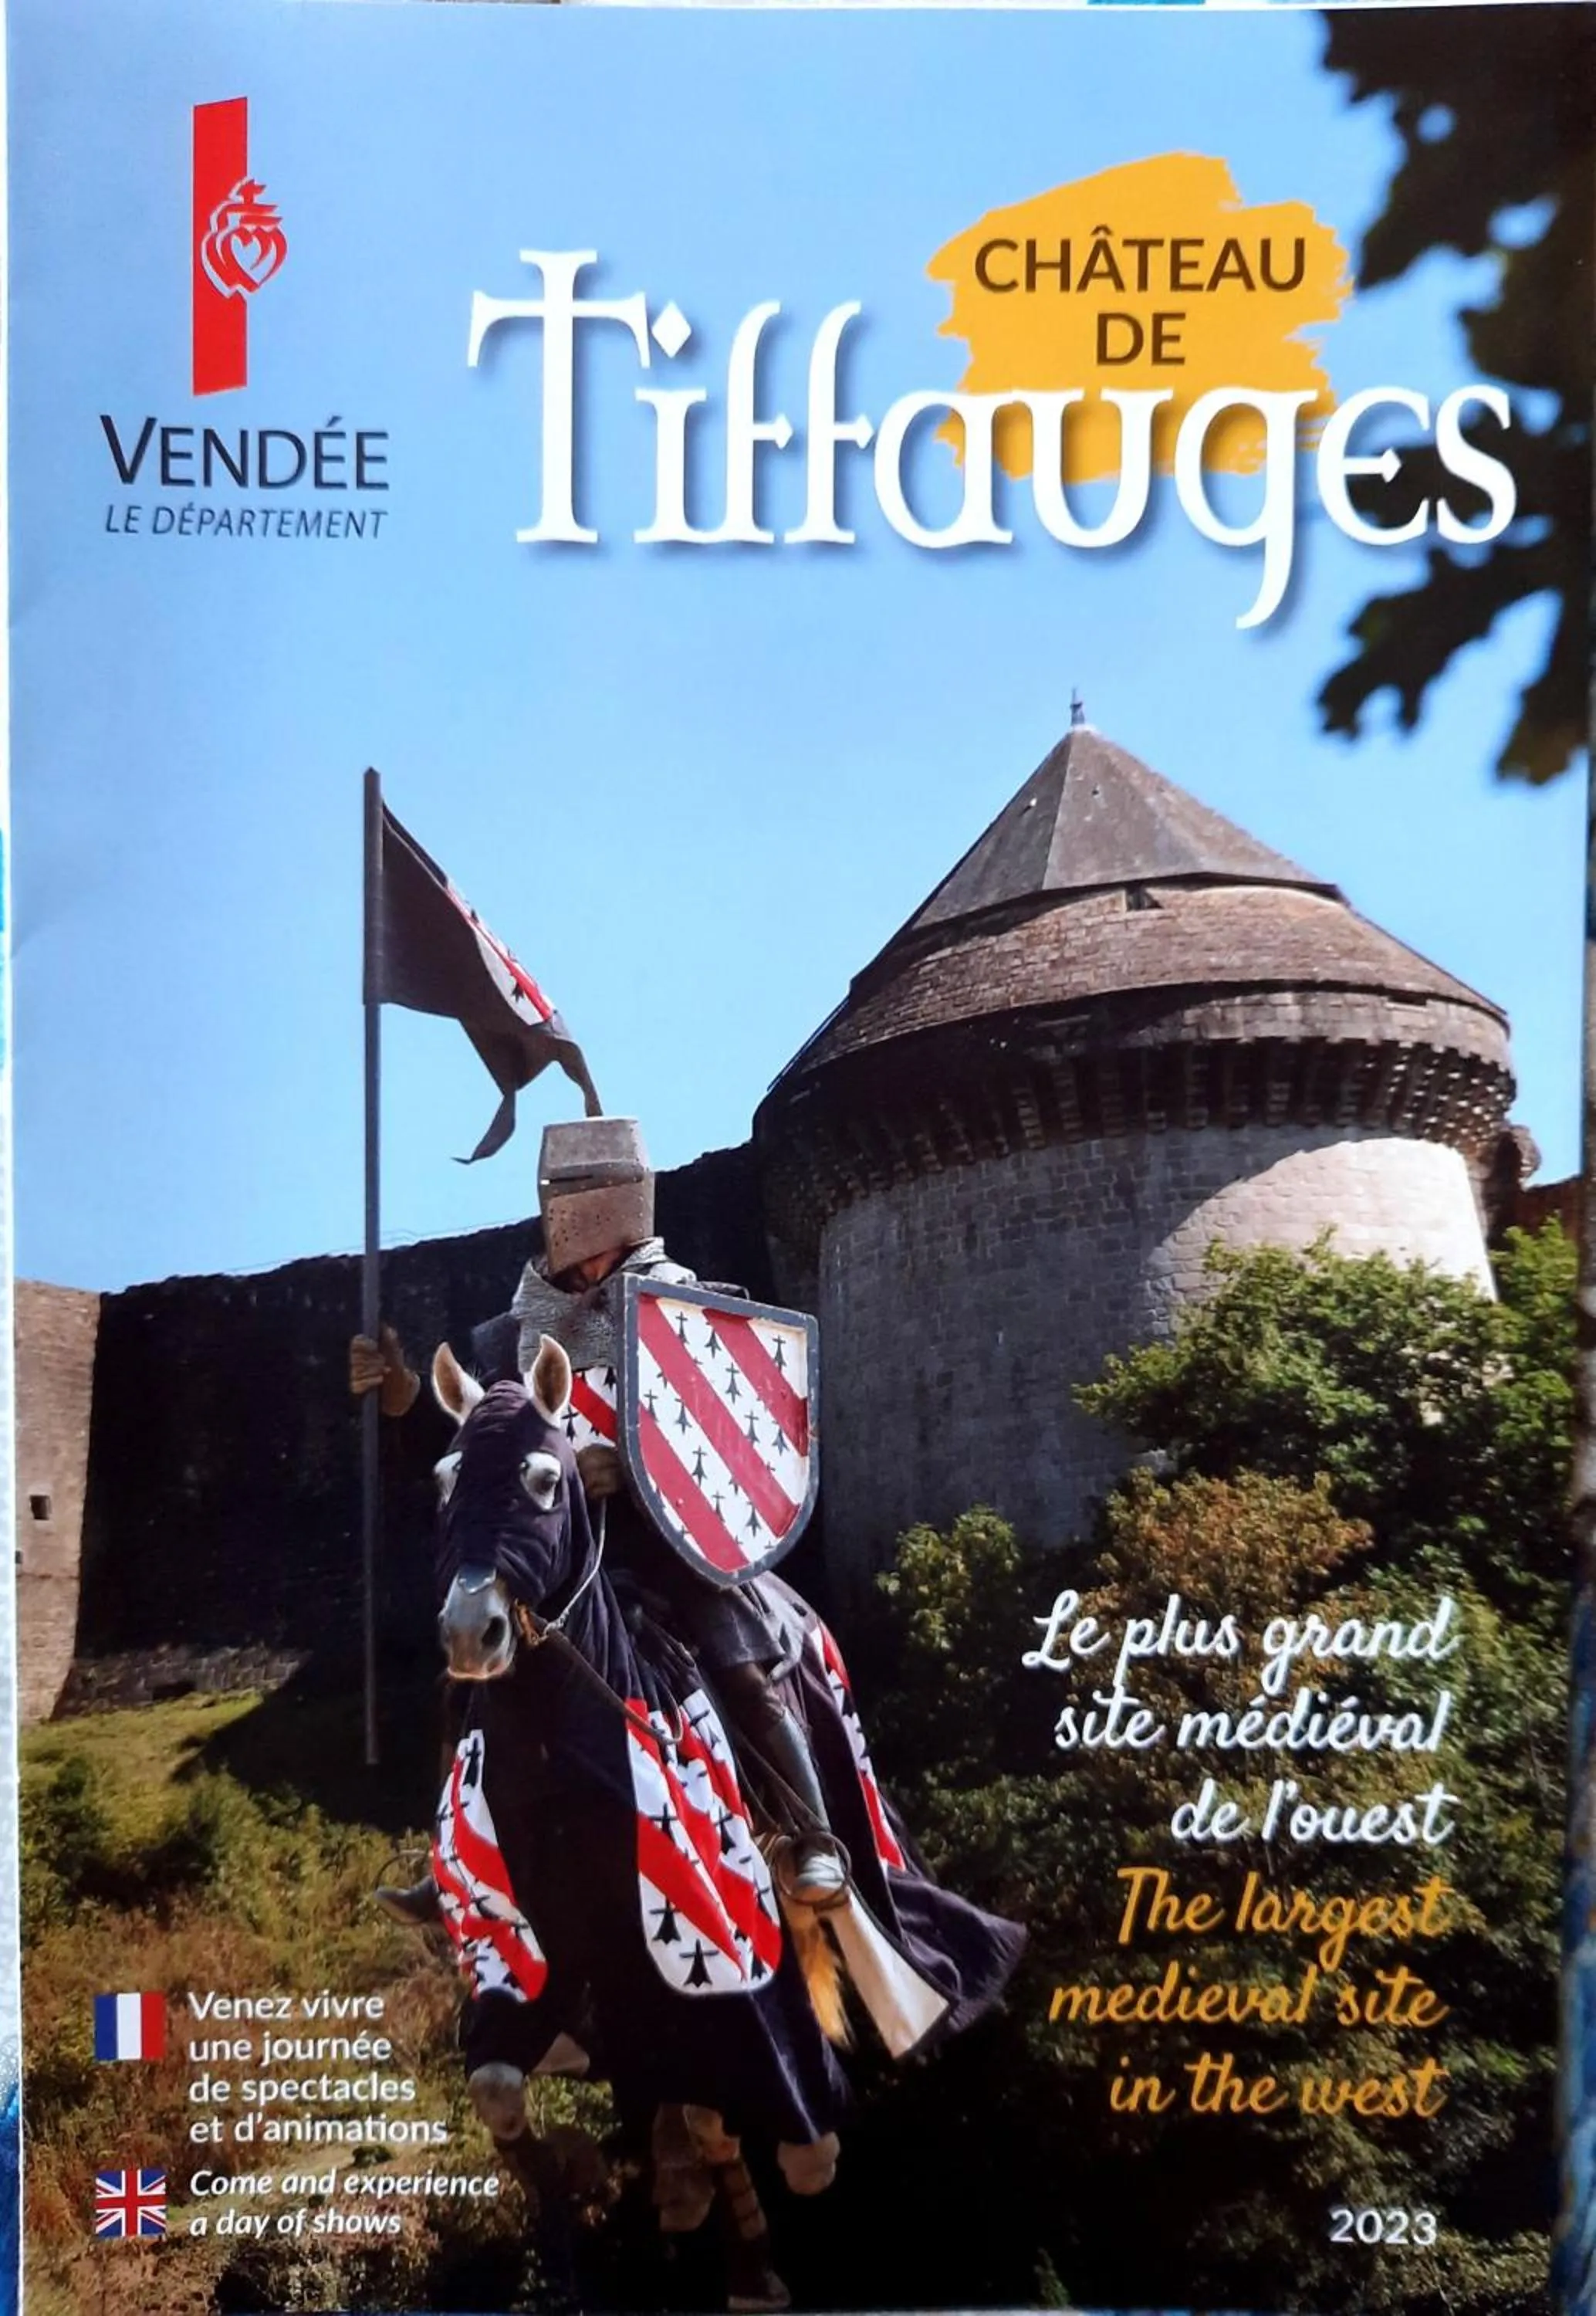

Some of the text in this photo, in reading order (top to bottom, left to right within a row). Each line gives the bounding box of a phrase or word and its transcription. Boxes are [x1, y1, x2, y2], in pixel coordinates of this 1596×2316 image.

[975, 225, 1305, 293] CHÂTEAU
[1097, 313, 1187, 366] DE
[100, 415, 389, 489] VENDÉE
[468, 249, 1517, 629] Tiffauges
[106, 502, 388, 539] LE DÉPARTEMENT
[1022, 1589, 1460, 1695] Le plus grand
[1054, 1685, 1452, 1752] site médiéval
[1171, 1777, 1461, 1845] de l'ouest
[1118, 1866, 1455, 1972] The largest
[188, 1991, 385, 2020] Venez vivre
[1049, 1961, 1449, 2027] medieval site
[190, 2031, 392, 2067] une journée
[189, 2071, 416, 2106] de spectacles
[1110, 2052, 1452, 2118] in the west
[189, 2112, 448, 2143] et d'animations
[190, 2169, 499, 2201] Come and experience
[189, 2209, 401, 2239] a day of shows
[1329, 2209, 1438, 2245] 2023
